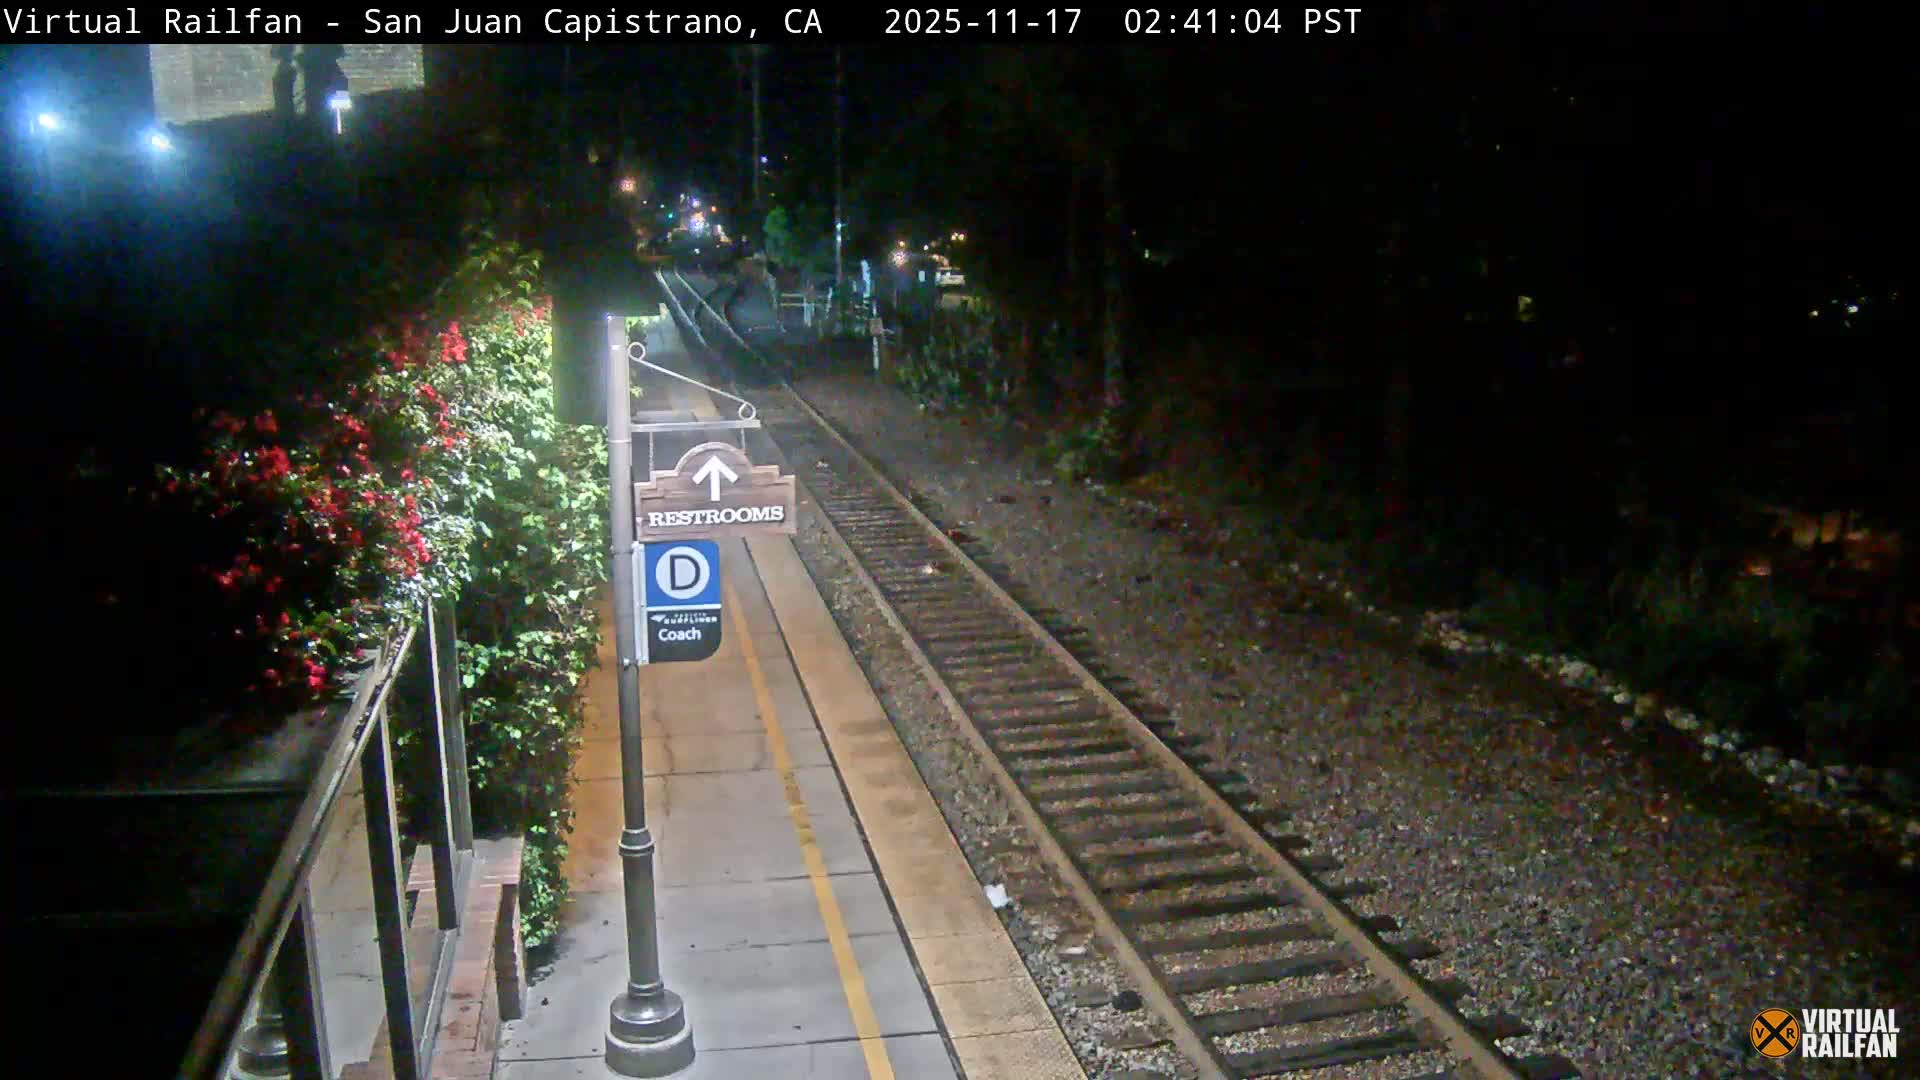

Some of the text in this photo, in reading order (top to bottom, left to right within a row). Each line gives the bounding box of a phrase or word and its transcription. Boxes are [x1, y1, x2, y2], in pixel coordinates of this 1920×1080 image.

[647, 505, 785, 528] RESTROOMS
[669, 554, 701, 591] D
[658, 627, 702, 642] Coach
